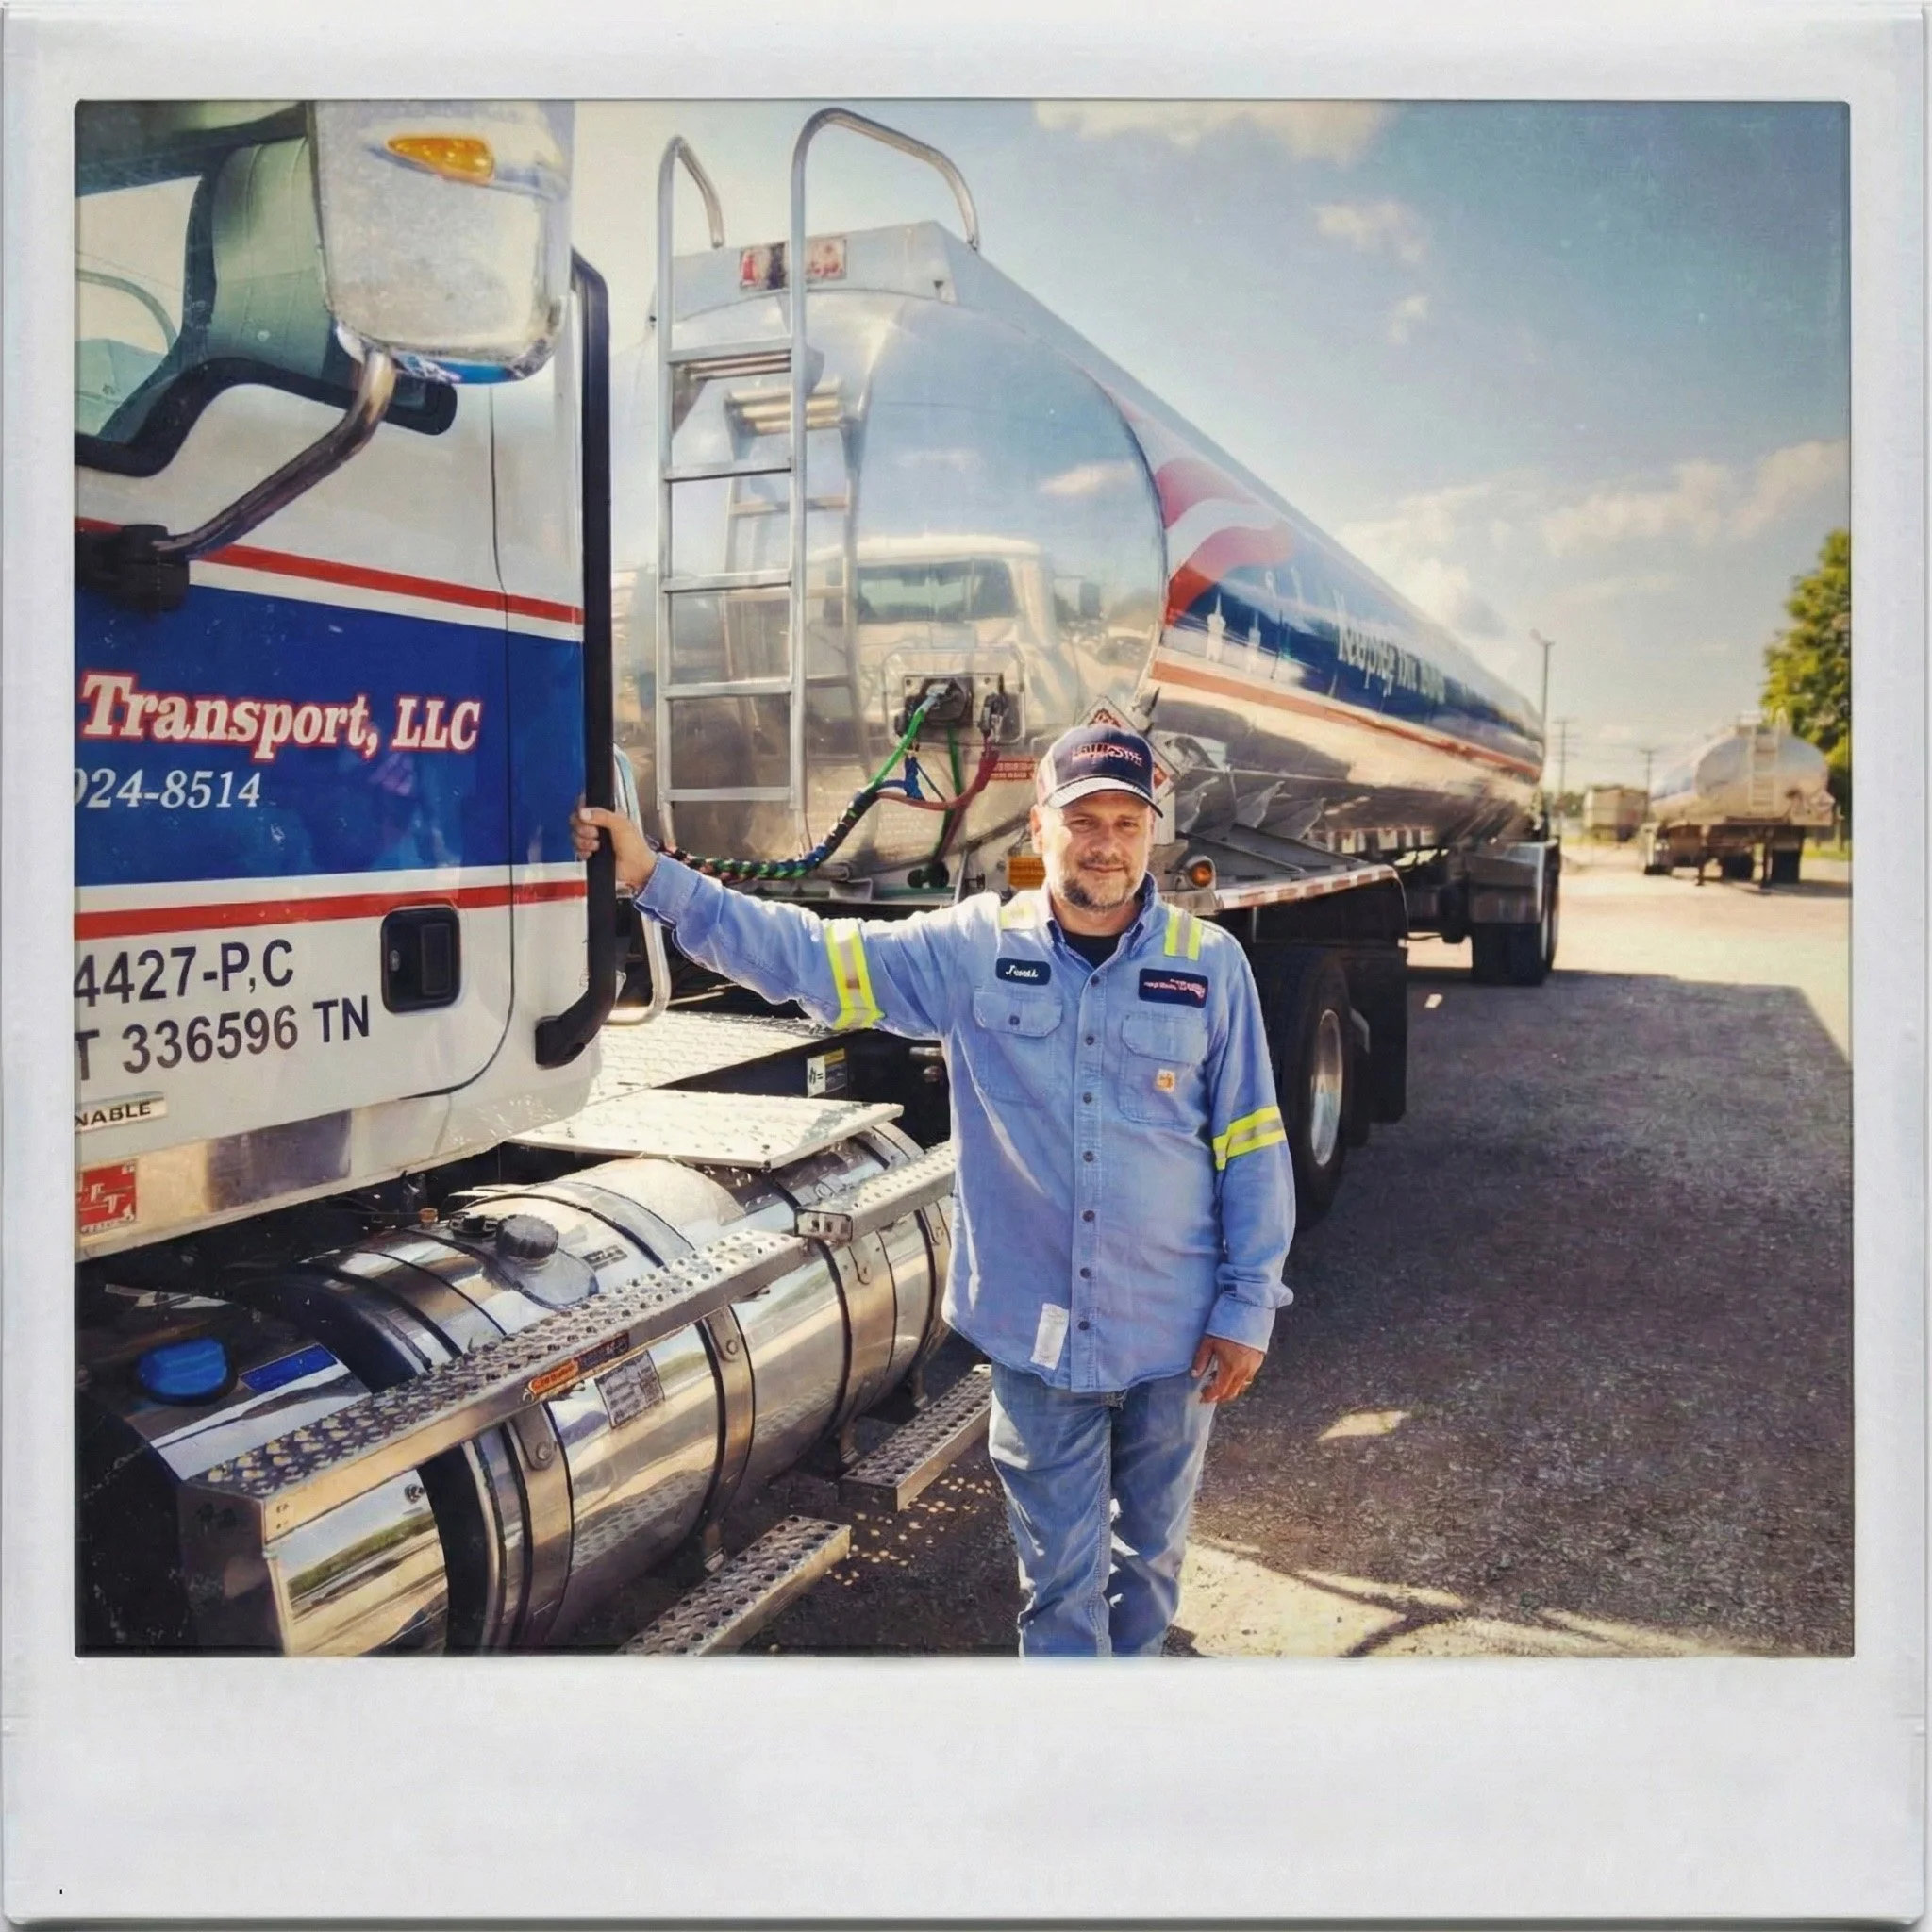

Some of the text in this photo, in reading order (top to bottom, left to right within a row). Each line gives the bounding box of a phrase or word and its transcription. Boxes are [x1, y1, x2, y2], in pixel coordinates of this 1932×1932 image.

[81, 672, 483, 762] Transport, LLC
[74, 939, 293, 1008] 4427-P,C
[122, 1004, 298, 1074] 336596
[312, 994, 370, 1043] TN
